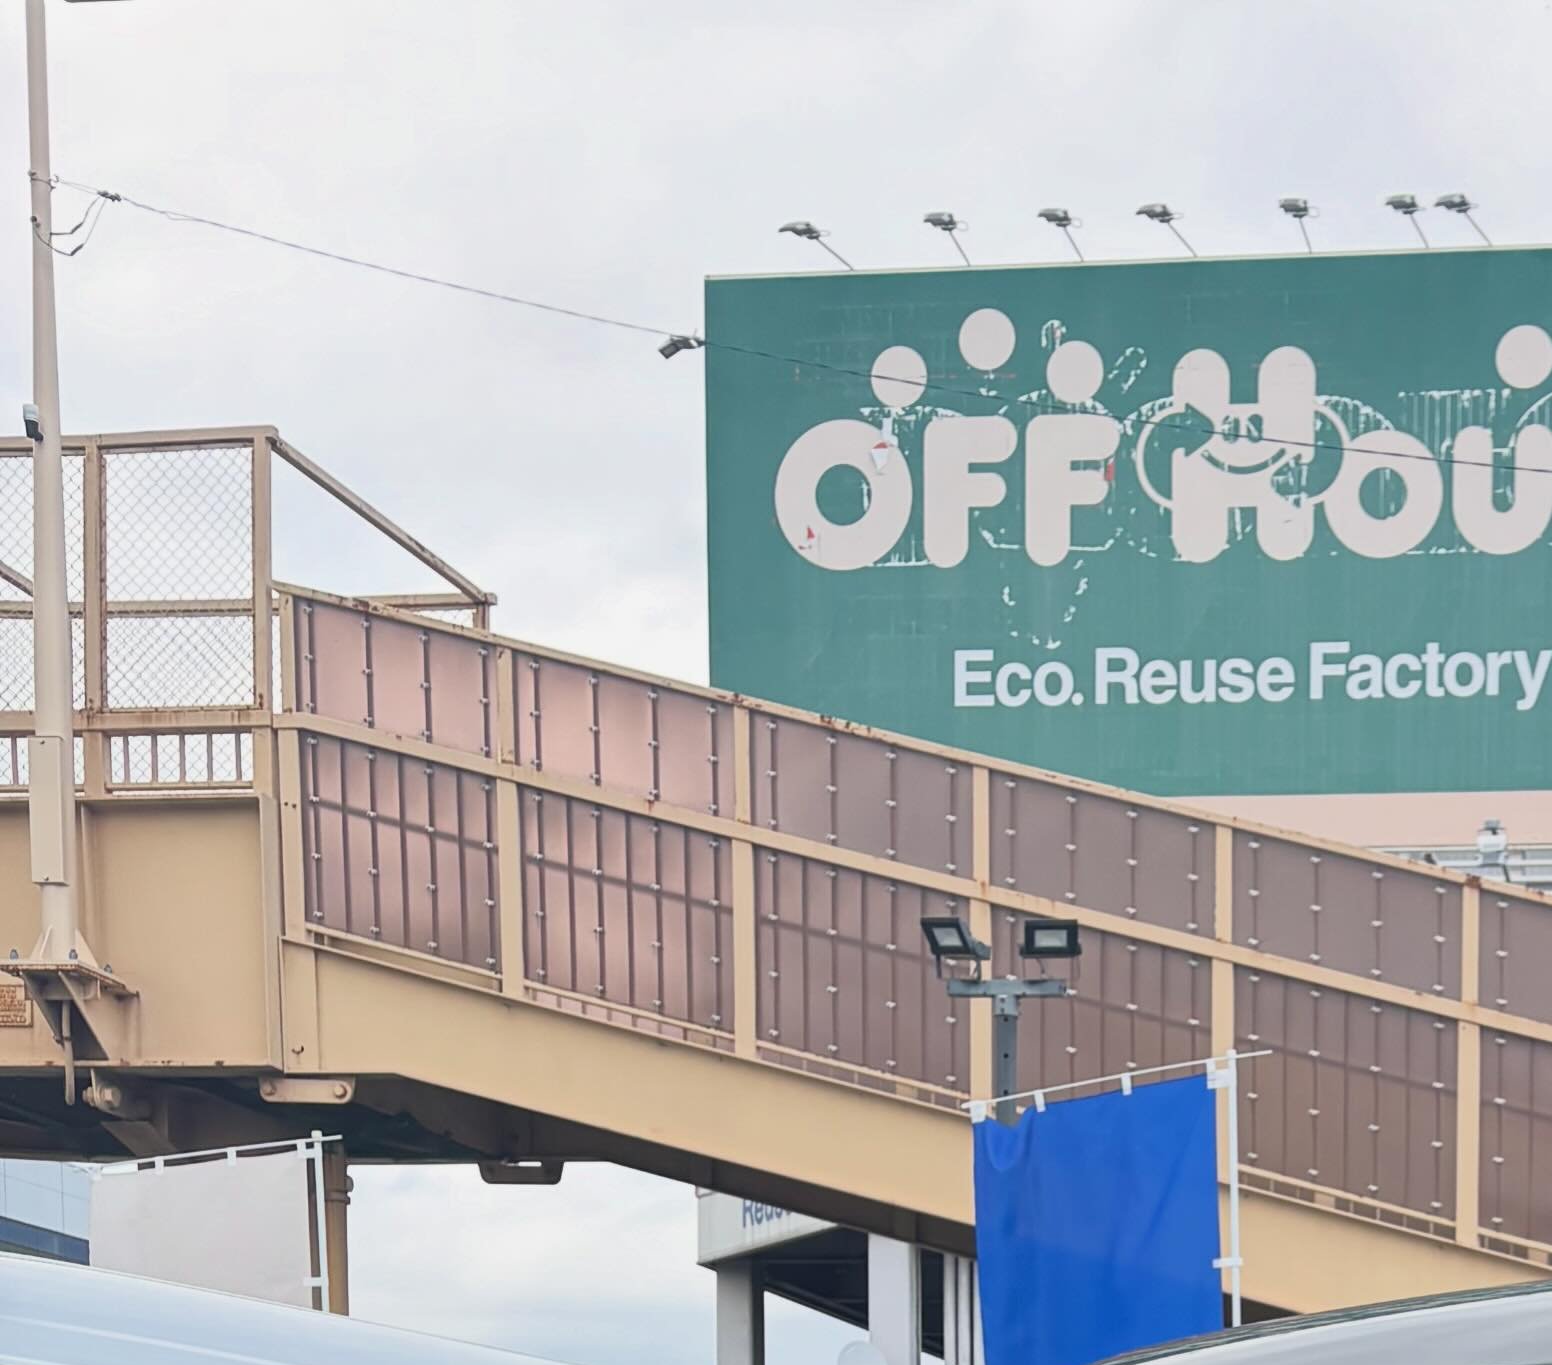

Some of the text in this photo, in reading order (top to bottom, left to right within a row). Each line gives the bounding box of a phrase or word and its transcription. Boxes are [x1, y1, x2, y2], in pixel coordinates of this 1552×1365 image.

[774, 412, 1122, 571] OFF
[953, 640, 1552, 712] Eco. Reuse Factory
